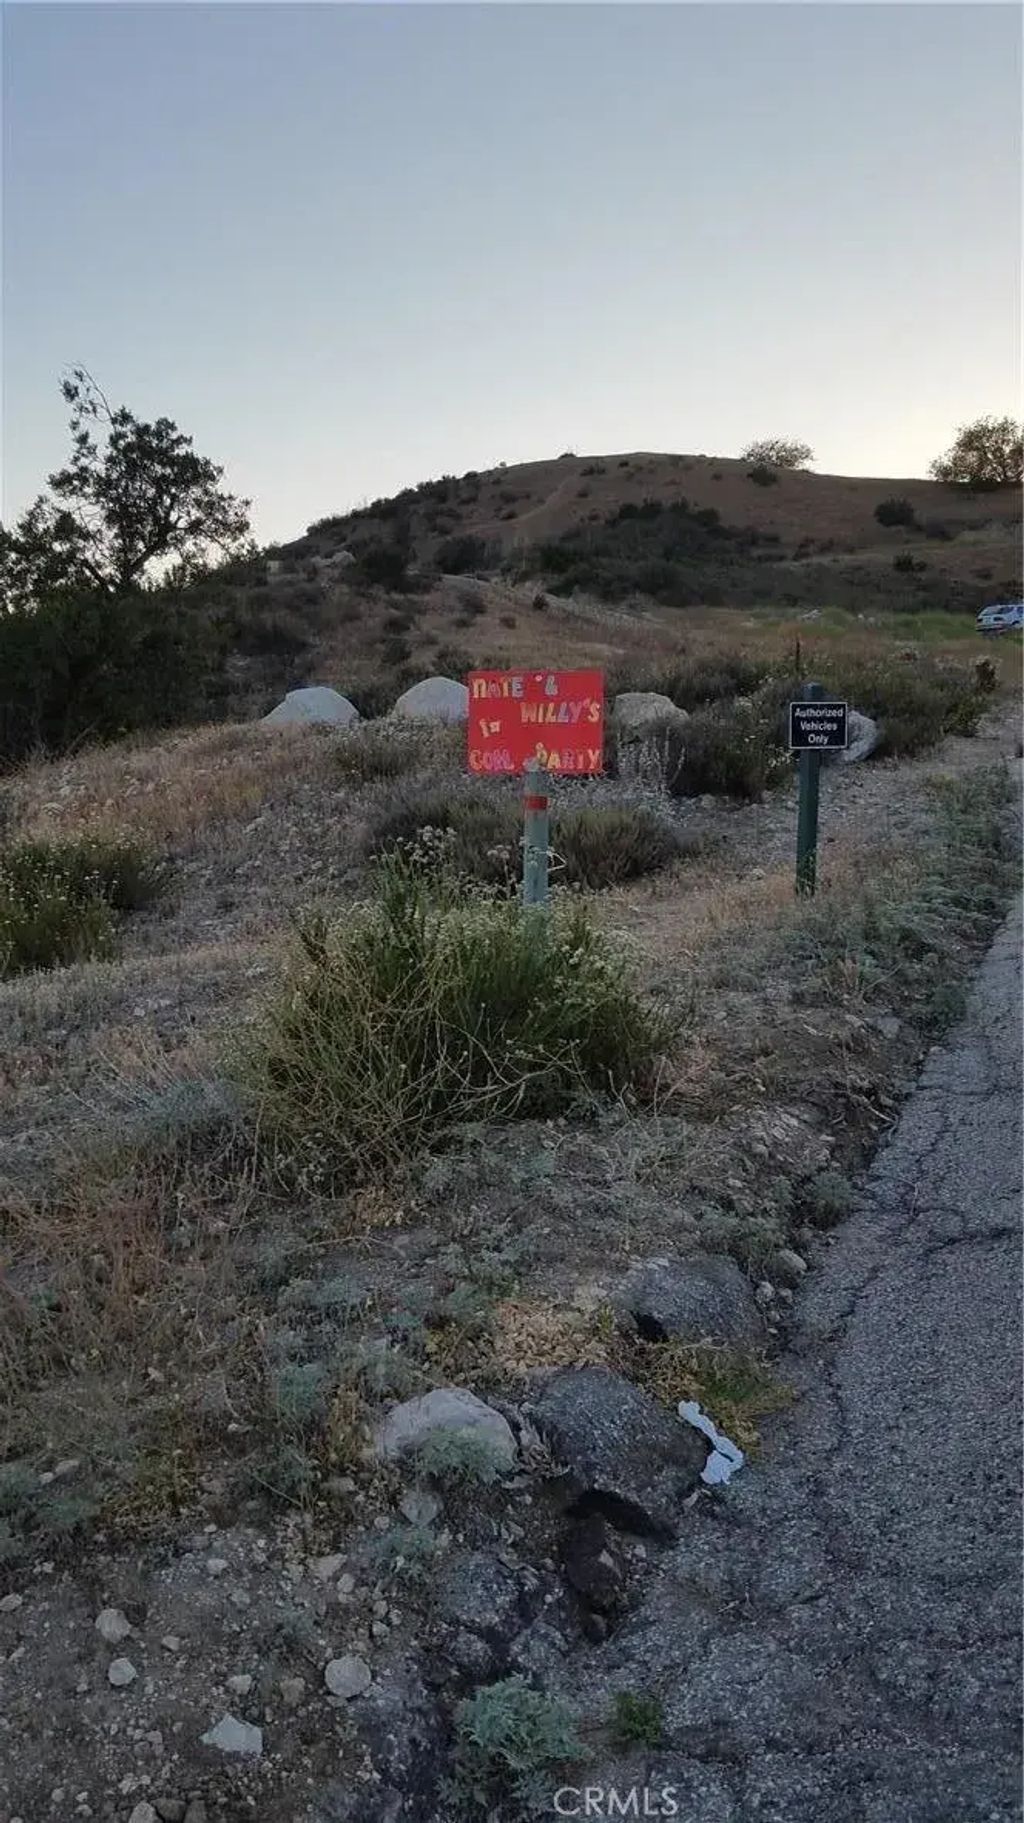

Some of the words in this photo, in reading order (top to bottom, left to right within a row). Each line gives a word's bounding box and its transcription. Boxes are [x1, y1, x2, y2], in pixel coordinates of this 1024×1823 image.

[520, 699, 600, 722] WILLY'S
[795, 707, 843, 717] Authorized
[800, 720, 837, 731] Vehicles
[808, 733, 829, 745] Only
